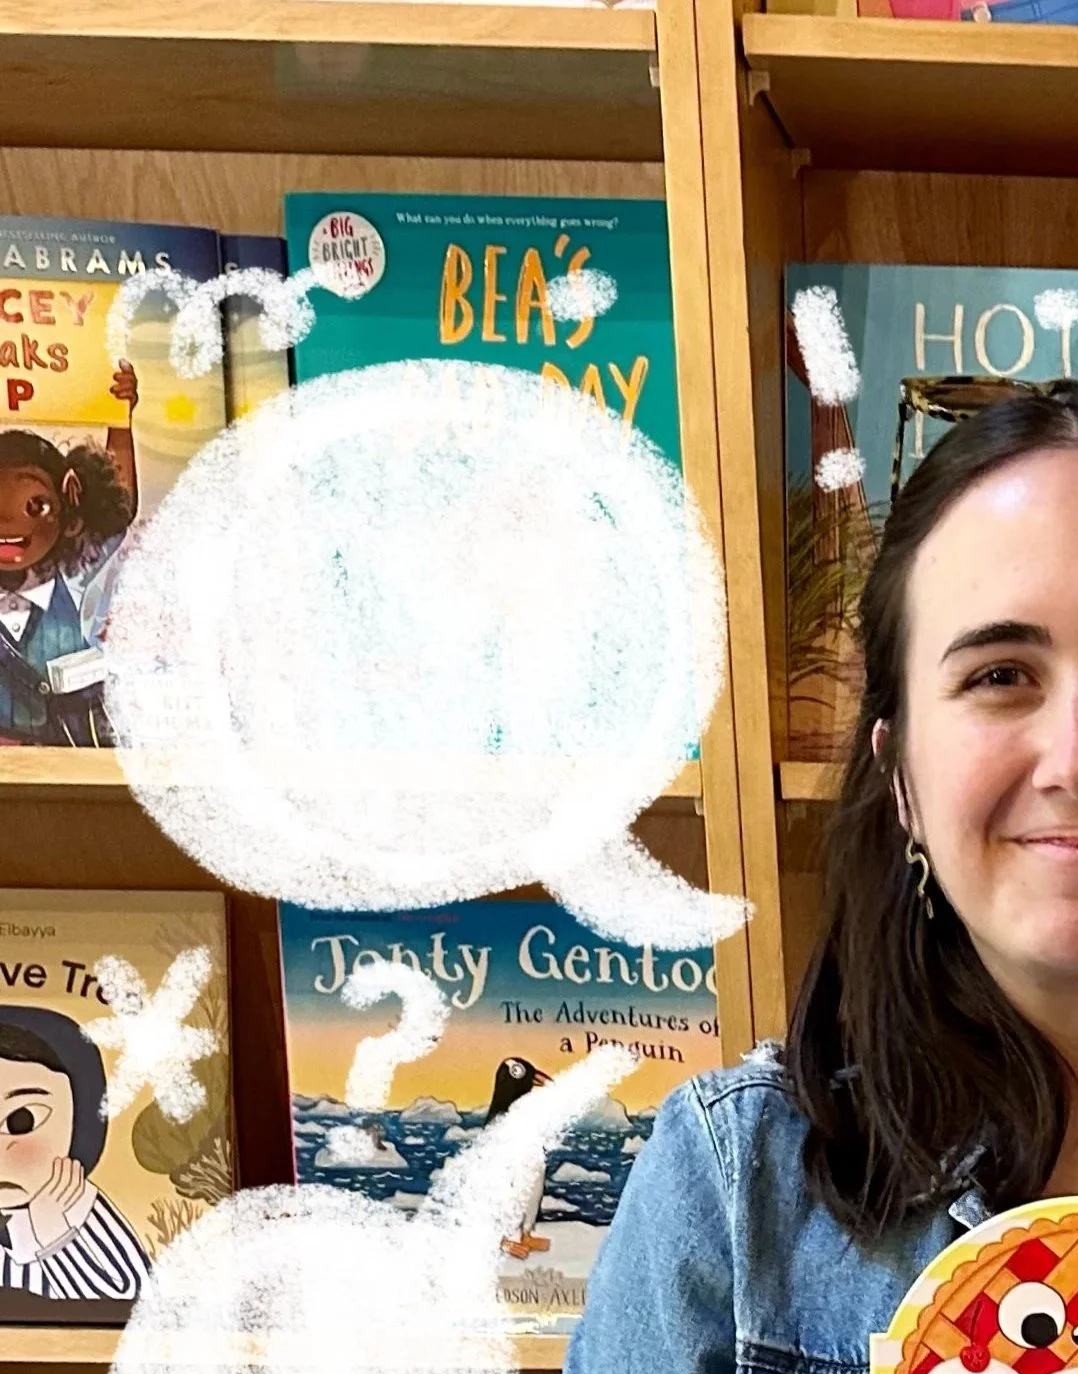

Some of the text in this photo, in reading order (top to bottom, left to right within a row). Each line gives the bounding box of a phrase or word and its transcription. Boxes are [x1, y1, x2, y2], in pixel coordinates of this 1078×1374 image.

[330, 216, 354, 238] BIG
[3, 243, 173, 277] ABRAMS
[323, 237, 367, 262] BRIGHT
[0, 333, 70, 372] aks
[7, 378, 35, 411] P
[0, 961, 47, 989] ve
[310, 931, 492, 1010] Jonty
[500, 1001, 544, 1025] The
[556, 1002, 690, 1033] Adventures
[559, 1036, 574, 1054] a
